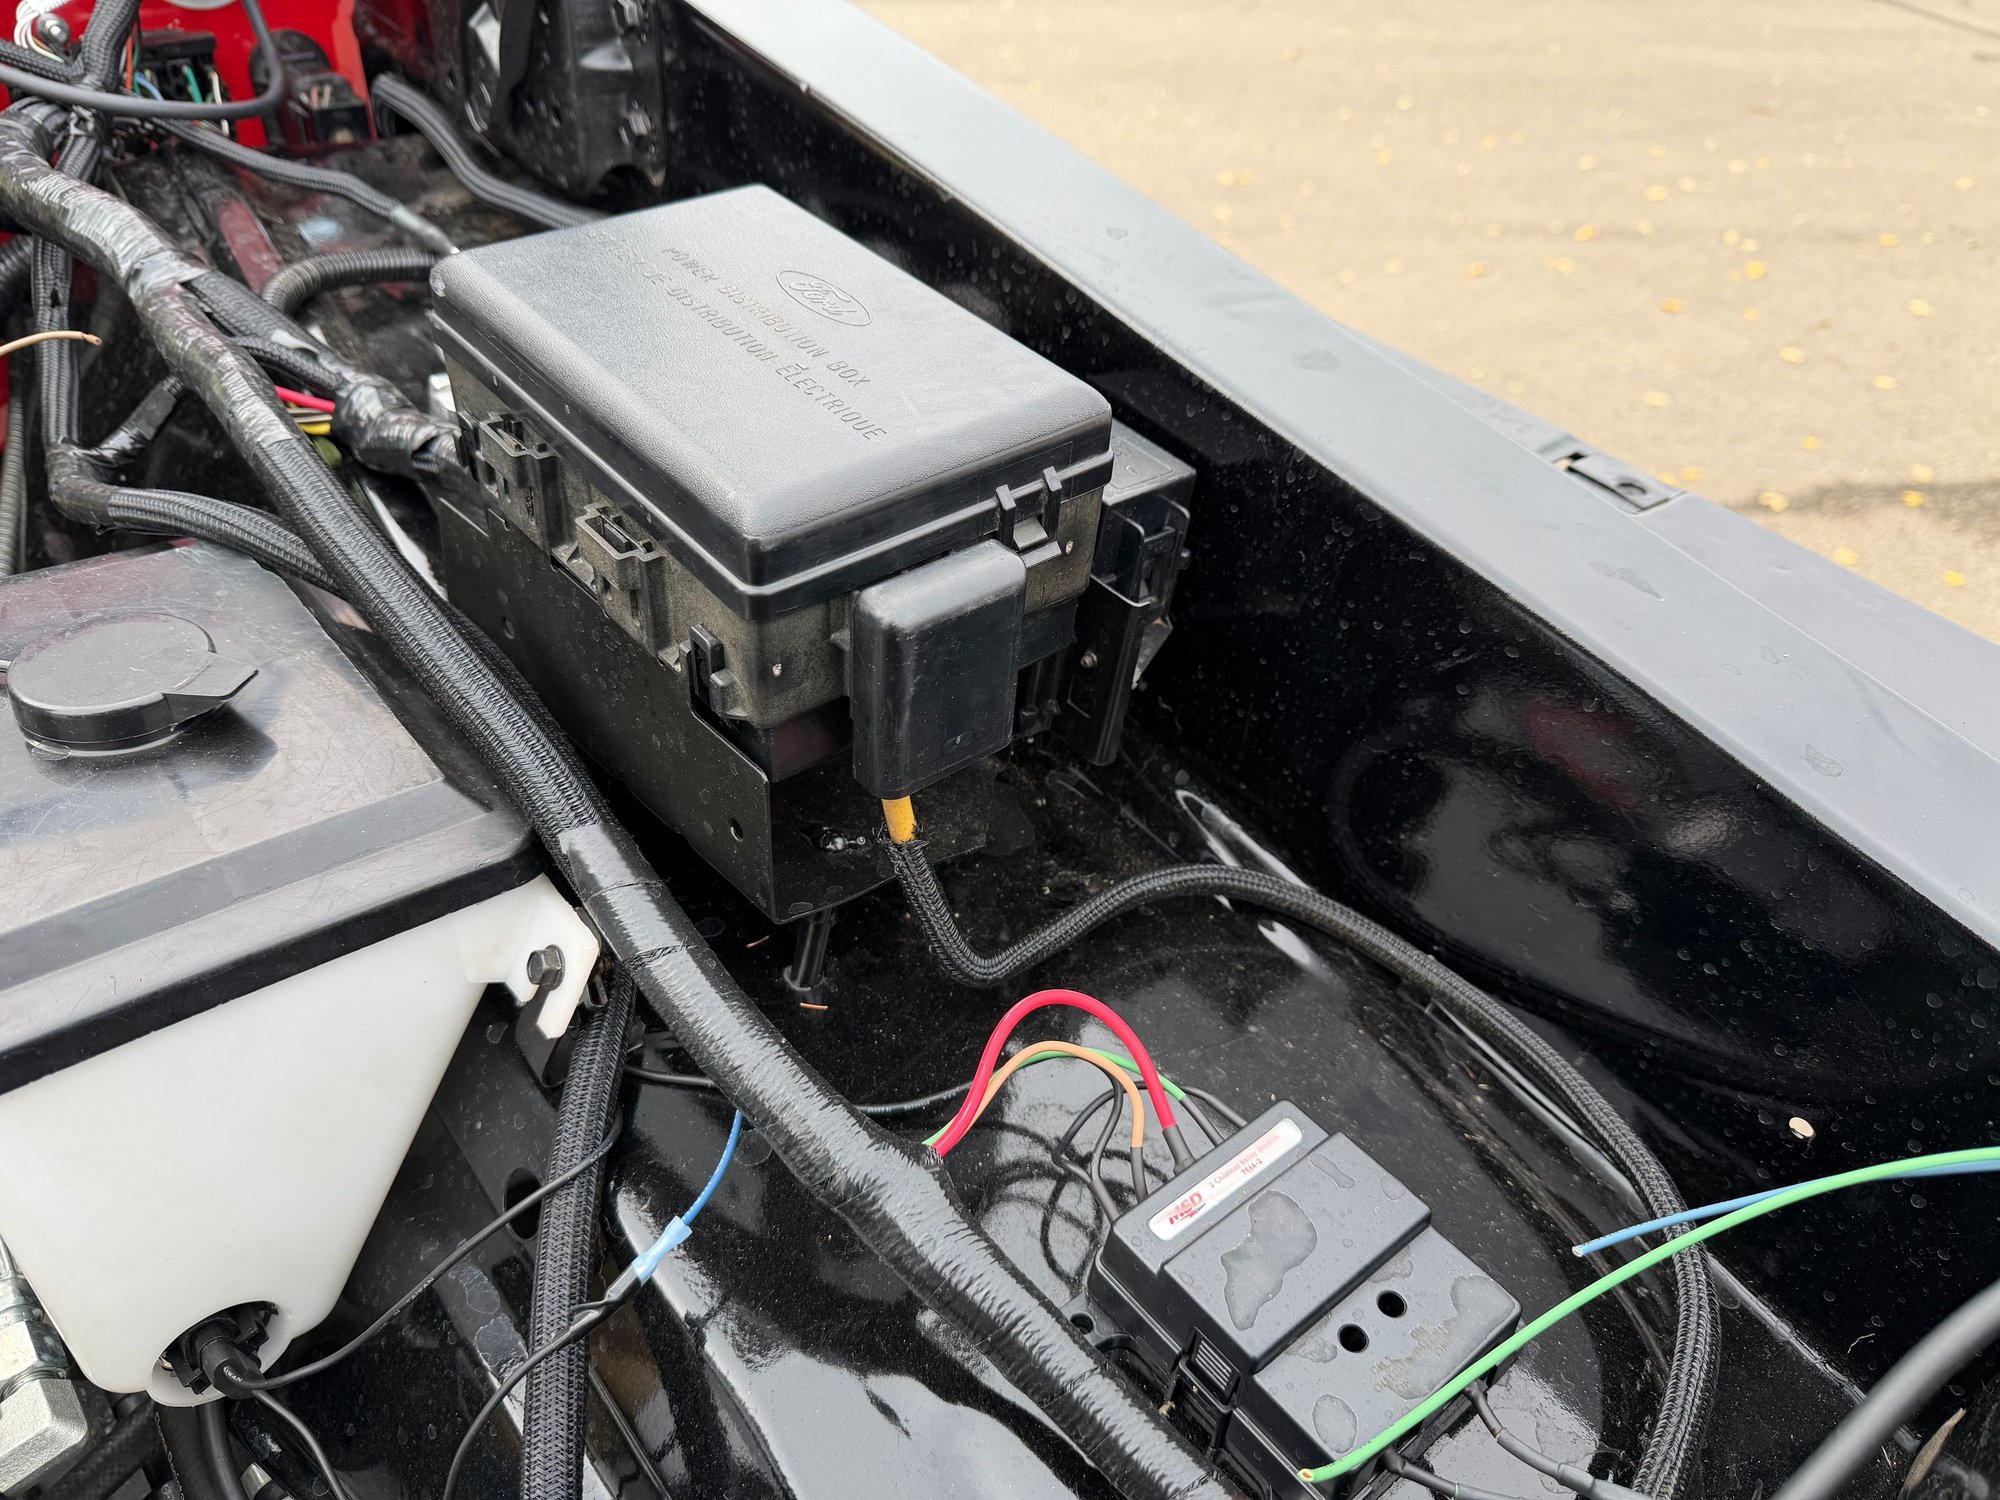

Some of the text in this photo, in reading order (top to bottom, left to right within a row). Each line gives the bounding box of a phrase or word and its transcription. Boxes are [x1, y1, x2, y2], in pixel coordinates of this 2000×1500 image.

[661, 247, 720, 283] POWER
[717, 284, 830, 358] DISTRIBUTION
[826, 360, 871, 387] BOX
[667, 286, 778, 362] DISTRIBUTION
[1168, 1191, 1202, 1225] MSD
